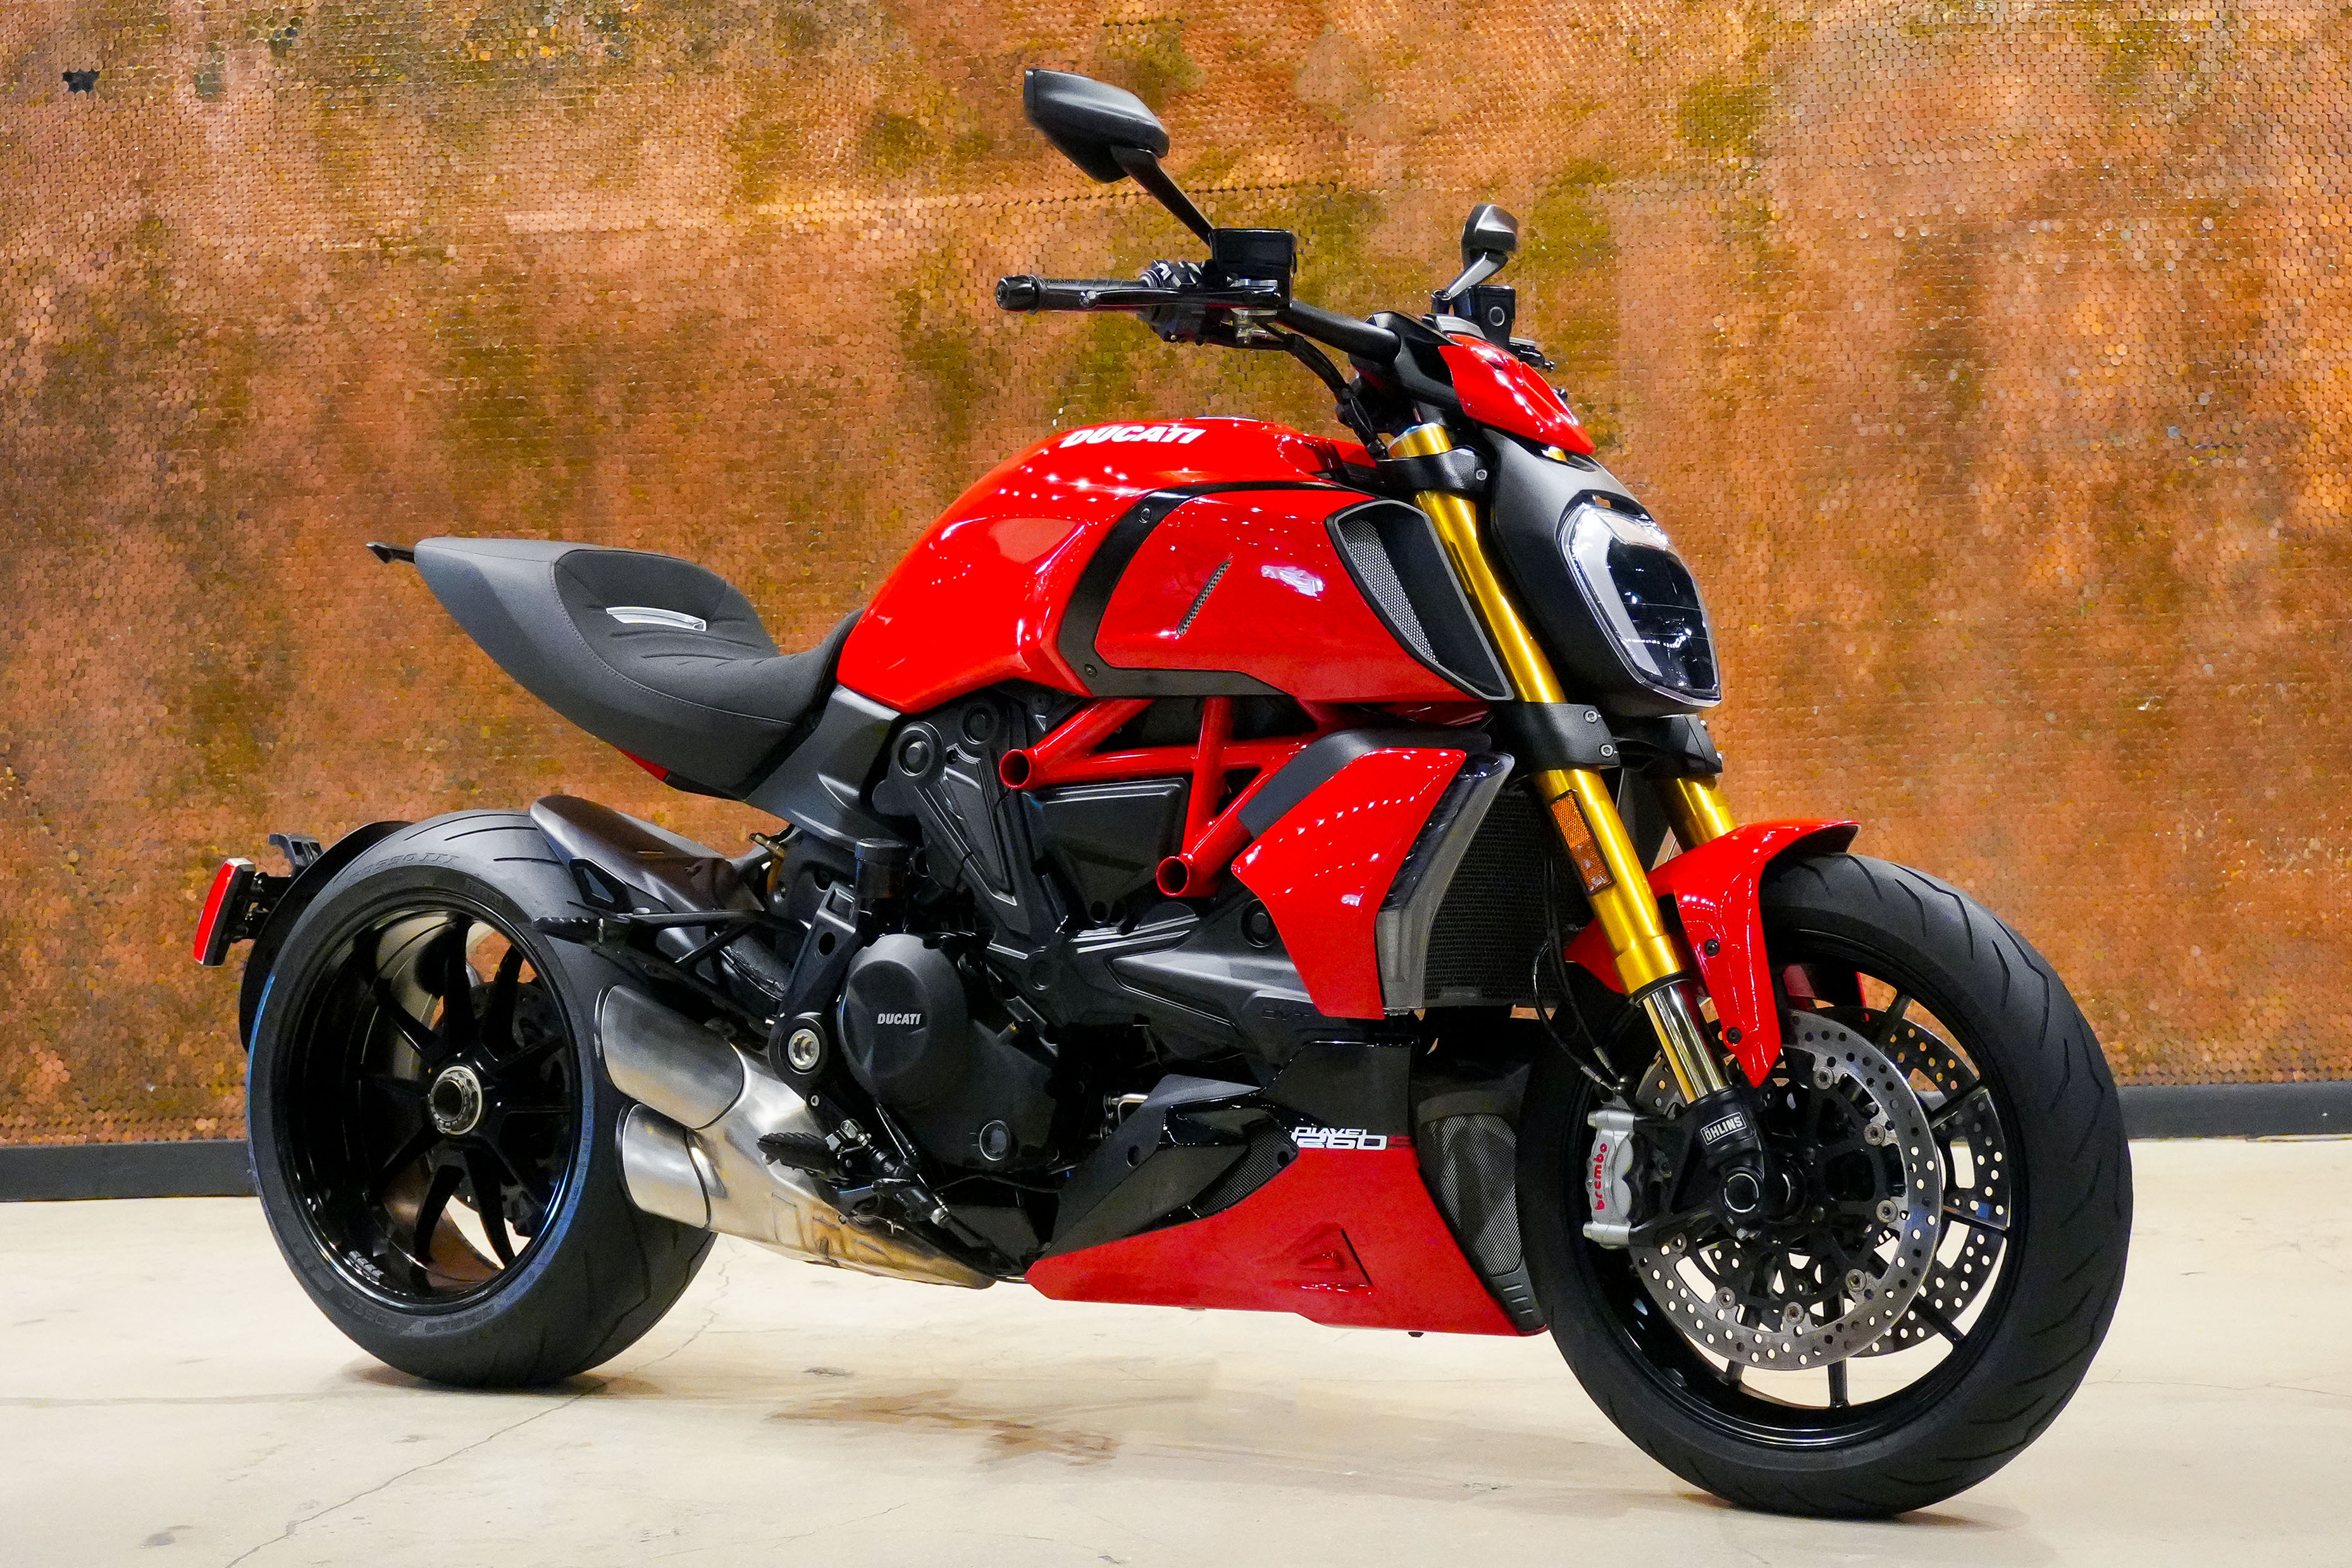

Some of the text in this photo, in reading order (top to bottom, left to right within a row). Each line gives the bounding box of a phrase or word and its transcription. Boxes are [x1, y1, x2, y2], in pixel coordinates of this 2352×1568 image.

[1059, 426, 1206, 448] DUCATI
[877, 1013, 922, 1025] DUCATI
[1703, 1116, 1743, 1141] ÖHLINS
[1593, 1142, 1607, 1210] brembo
